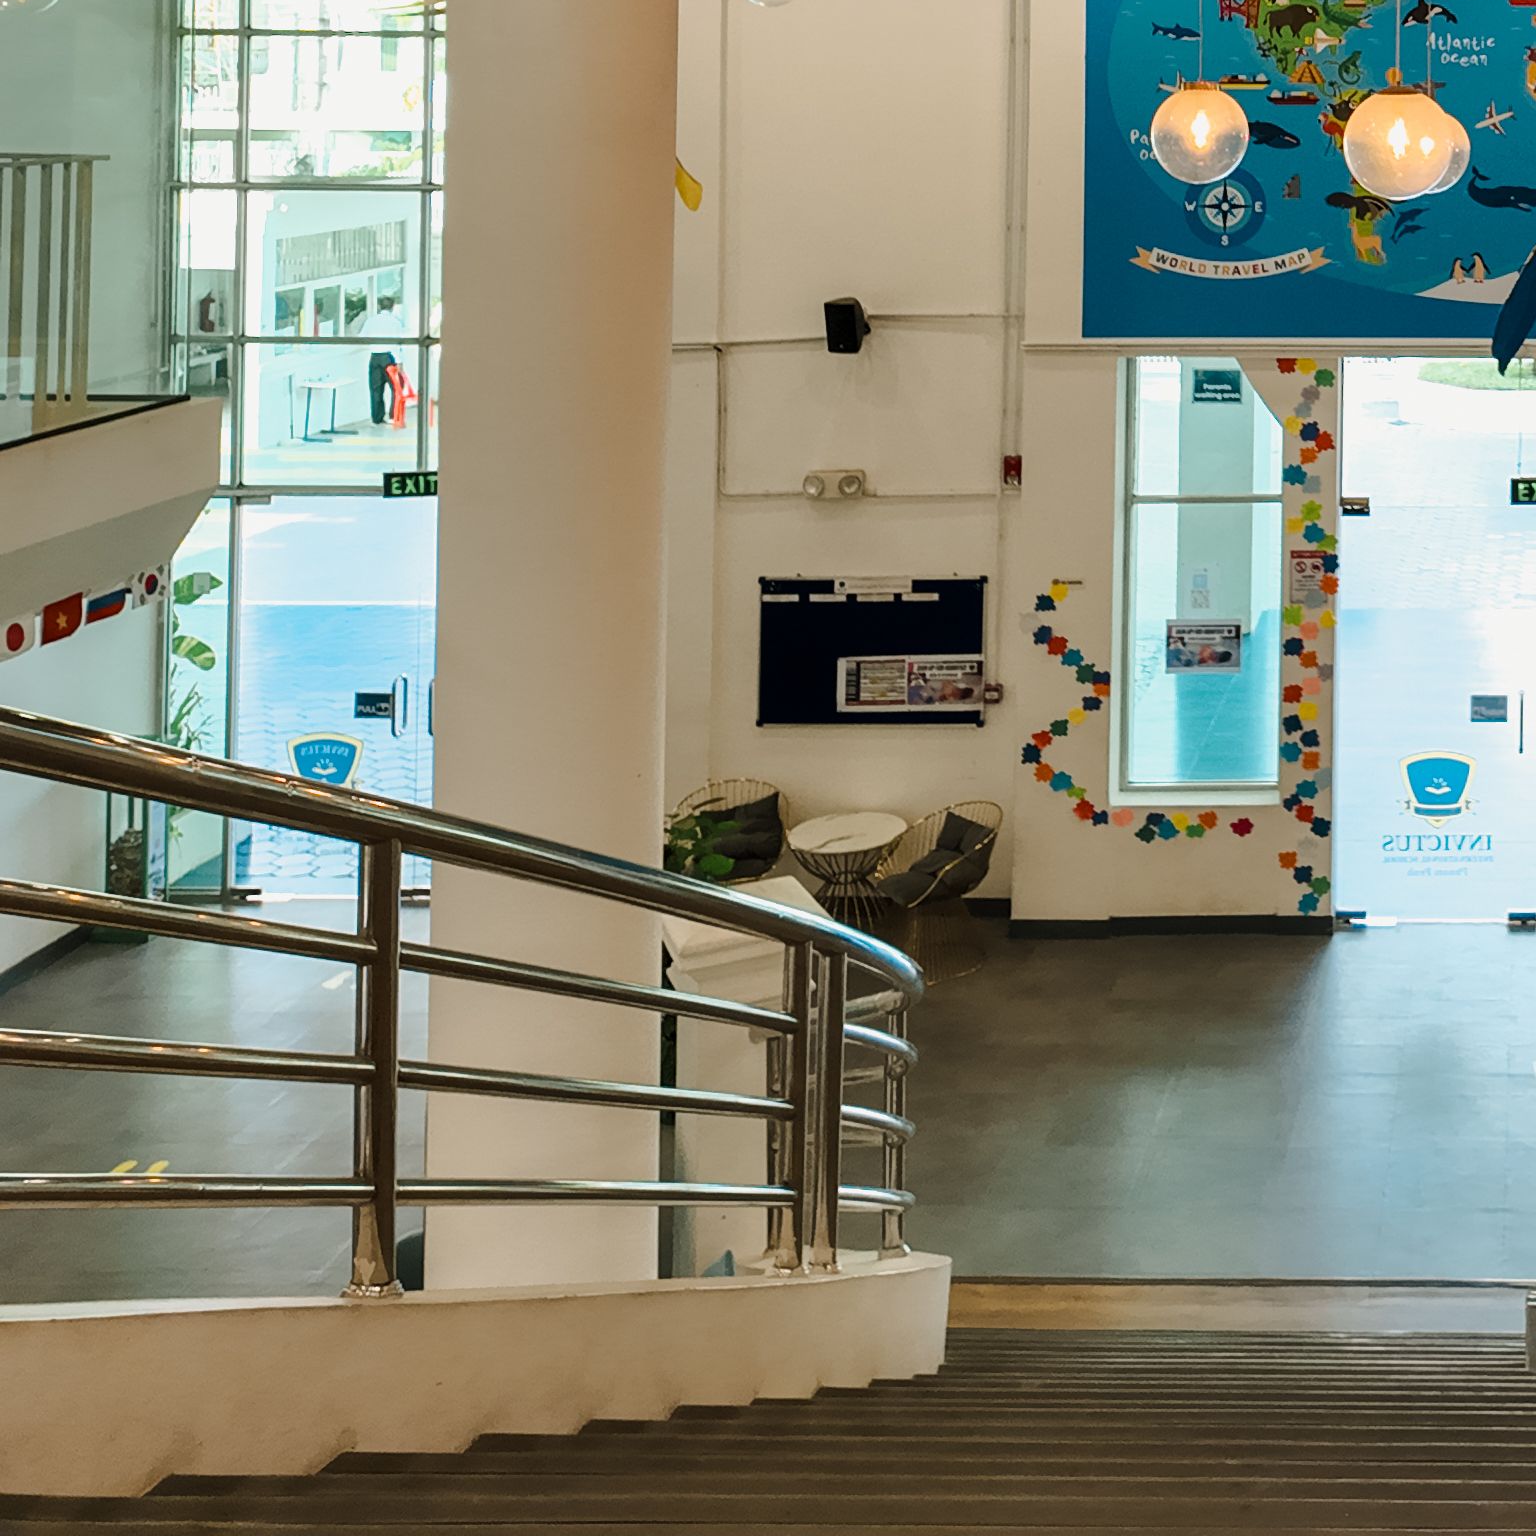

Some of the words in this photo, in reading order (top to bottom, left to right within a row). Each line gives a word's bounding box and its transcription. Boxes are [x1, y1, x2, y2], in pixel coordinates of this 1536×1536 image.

[1426, 31, 1496, 52] Atlantic
[1155, 252, 1207, 274] WORLD
[1212, 263, 1269, 277] TRAVEL
[1273, 252, 1306, 271] MAP
[391, 475, 438, 495] EXIT
